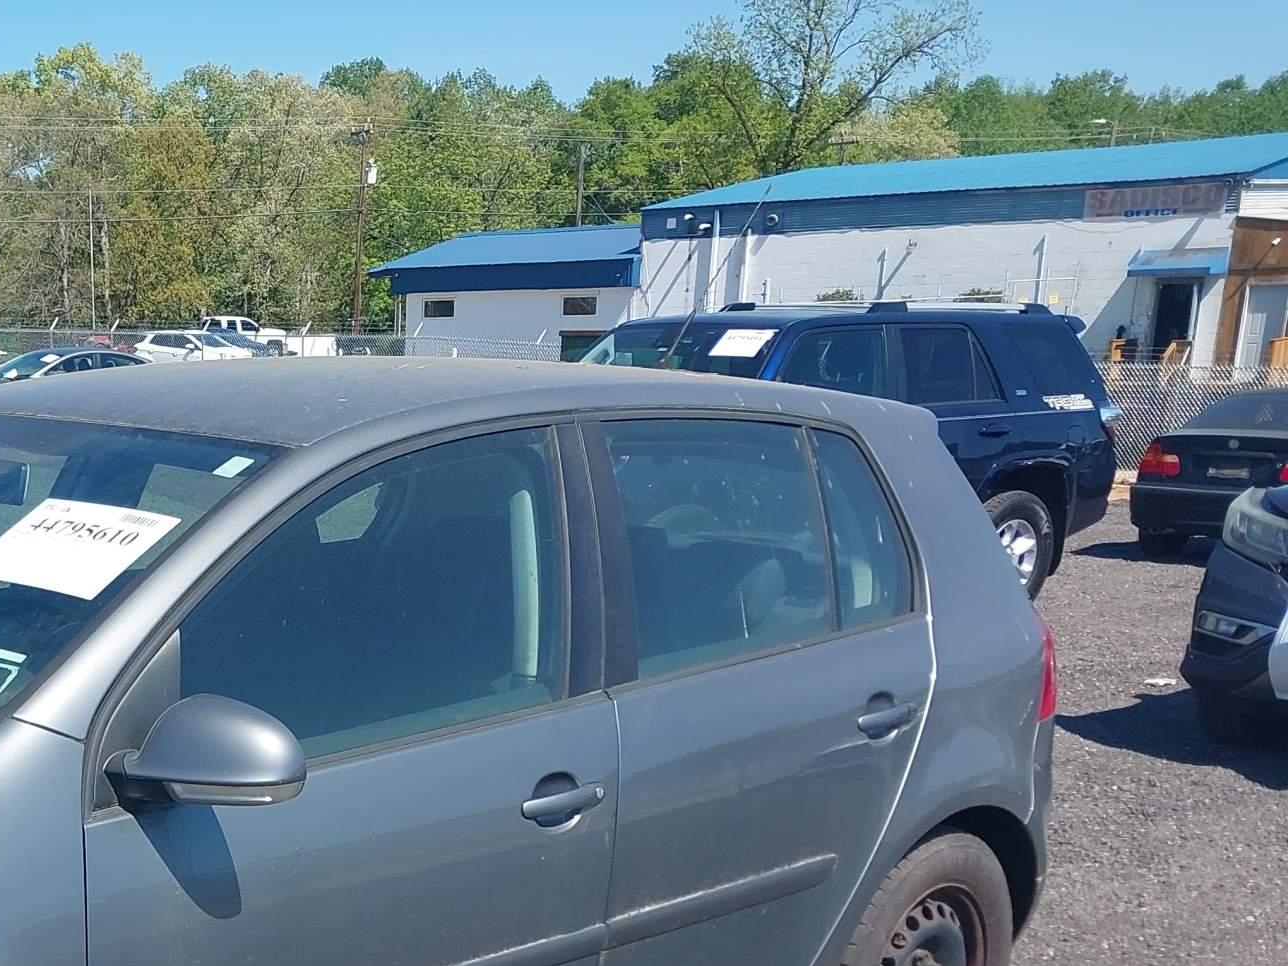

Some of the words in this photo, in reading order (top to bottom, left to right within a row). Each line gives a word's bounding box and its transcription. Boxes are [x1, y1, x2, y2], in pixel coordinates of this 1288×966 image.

[1090, 183, 1225, 210] SADISCO
[1123, 207, 1179, 218] OFFICE
[30, 517, 140, 547] 44795610
